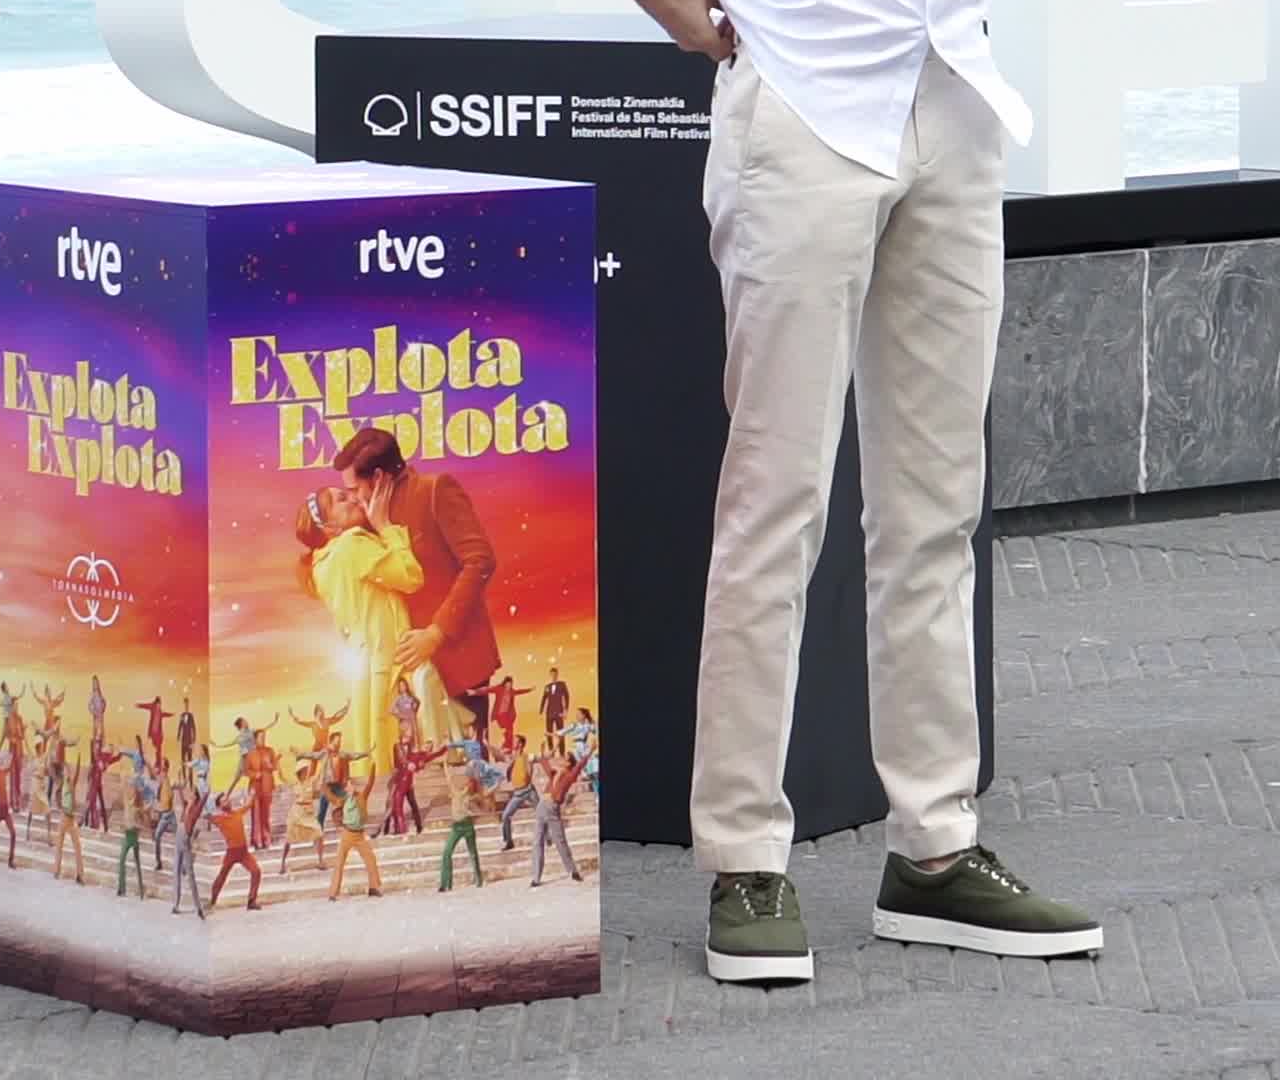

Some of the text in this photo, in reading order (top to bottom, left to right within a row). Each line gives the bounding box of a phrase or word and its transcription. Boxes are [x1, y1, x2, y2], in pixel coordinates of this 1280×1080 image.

[429, 93, 562, 137] SSIFF
[571, 96, 685, 109] Donostia Zinemaldia
[571, 111, 614, 123] Festival
[616, 112, 631, 123] de
[633, 112, 655, 123] San
[571, 127, 711, 140] International Film Festiva
[58, 227, 122, 295] rtve
[360, 229, 445, 279] rtve
[3, 352, 158, 432] Explota
[229, 325, 523, 416] Explota
[27, 415, 182, 496] Explota
